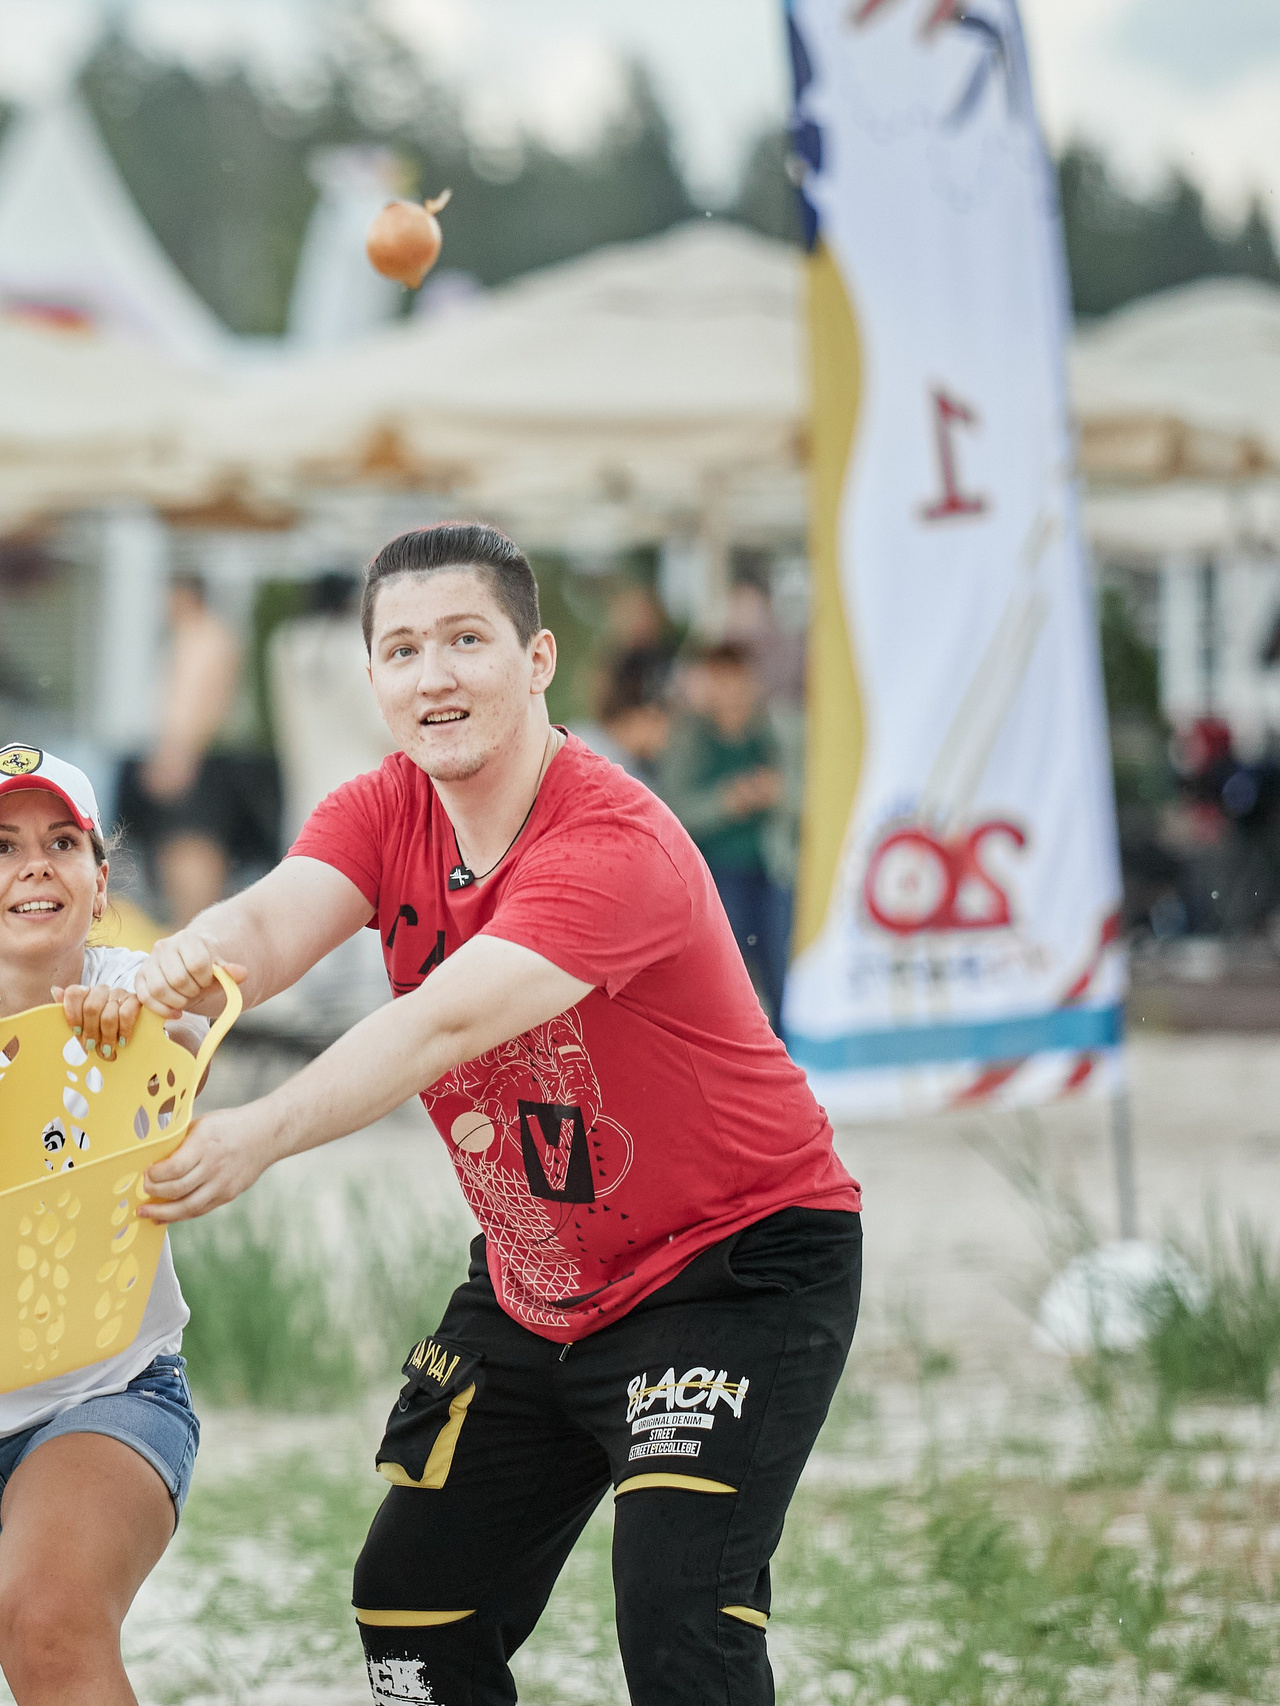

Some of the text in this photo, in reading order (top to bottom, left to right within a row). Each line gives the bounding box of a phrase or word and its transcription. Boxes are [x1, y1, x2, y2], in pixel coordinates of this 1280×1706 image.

[637, 1415, 703, 1430] ORIGINAL DENIM
[649, 1428, 677, 1441] STREET
